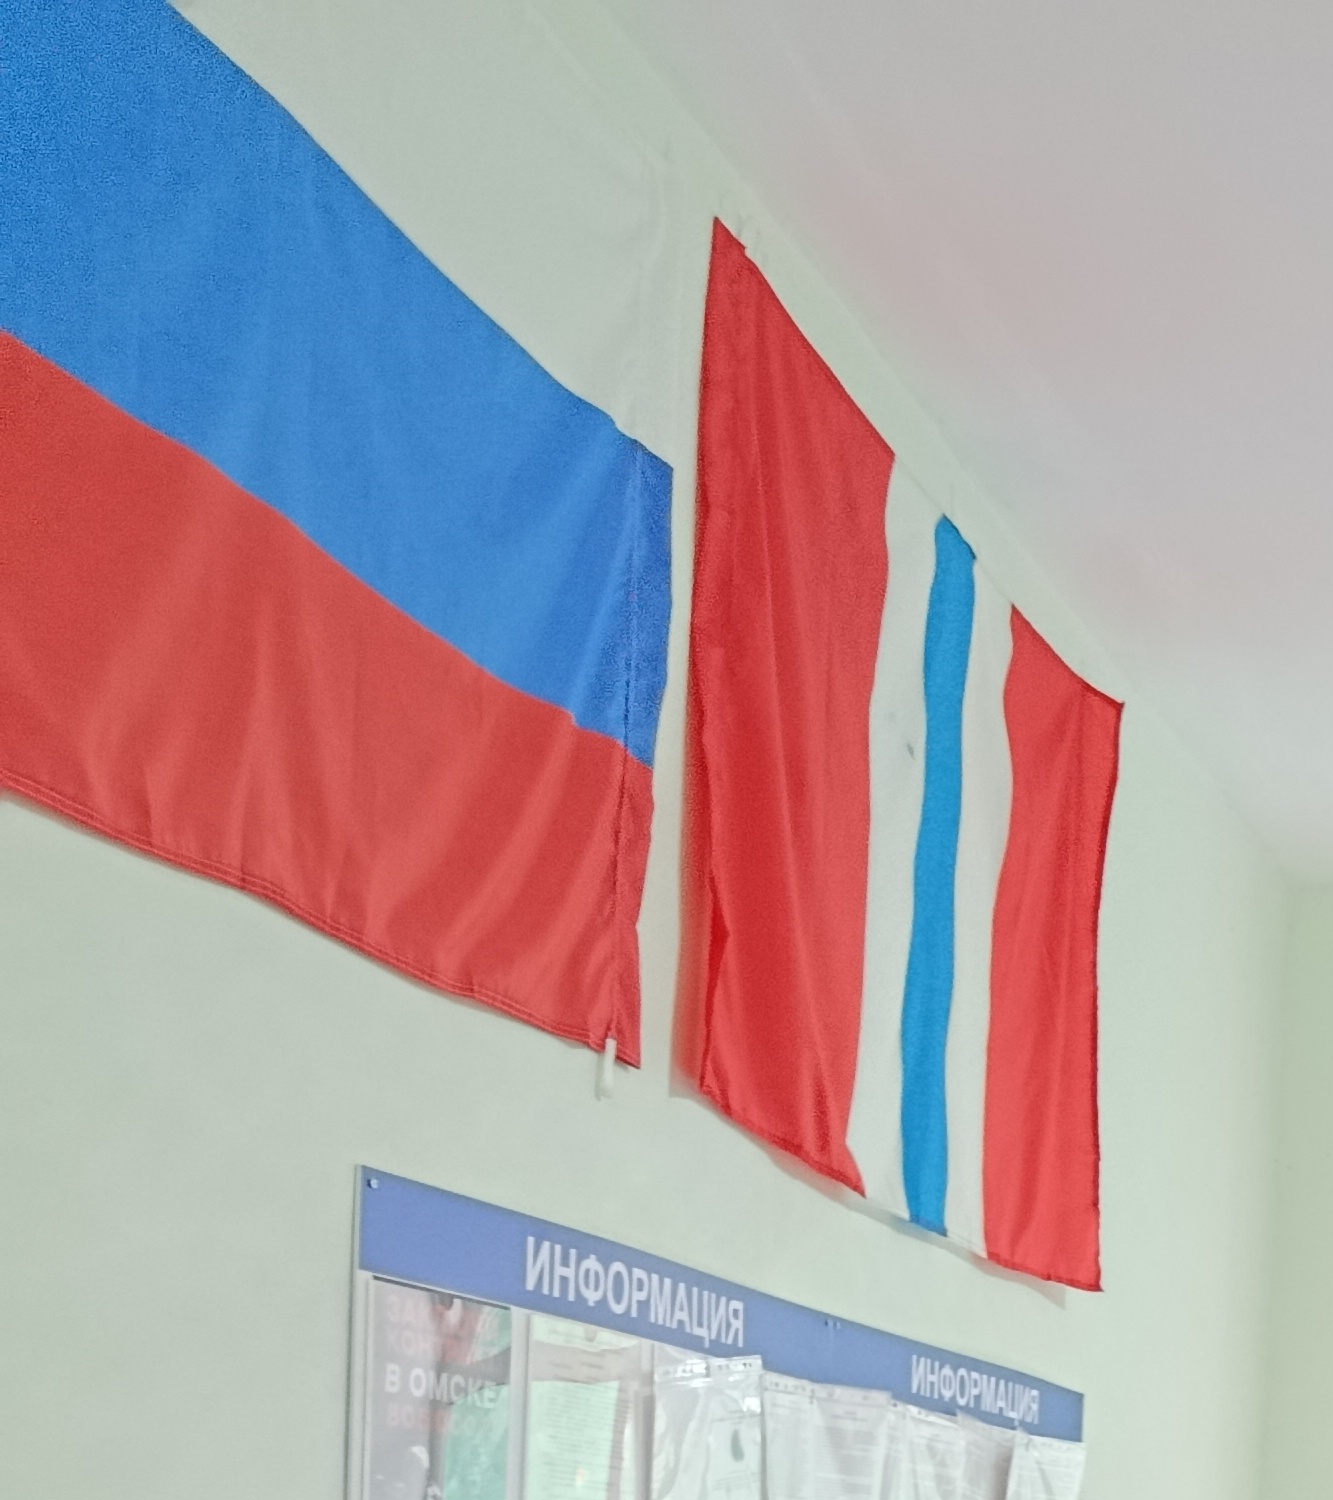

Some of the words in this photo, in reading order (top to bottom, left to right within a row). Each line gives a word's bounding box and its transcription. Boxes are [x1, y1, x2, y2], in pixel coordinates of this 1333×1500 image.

[525, 1235, 745, 1349] ИНФОРМАЦИЯ
[384, 1362, 401, 1394] В
[408, 1366, 498, 1410] ОМСКЕ
[910, 1354, 1040, 1426] ИНФОРМАЦИЯ
